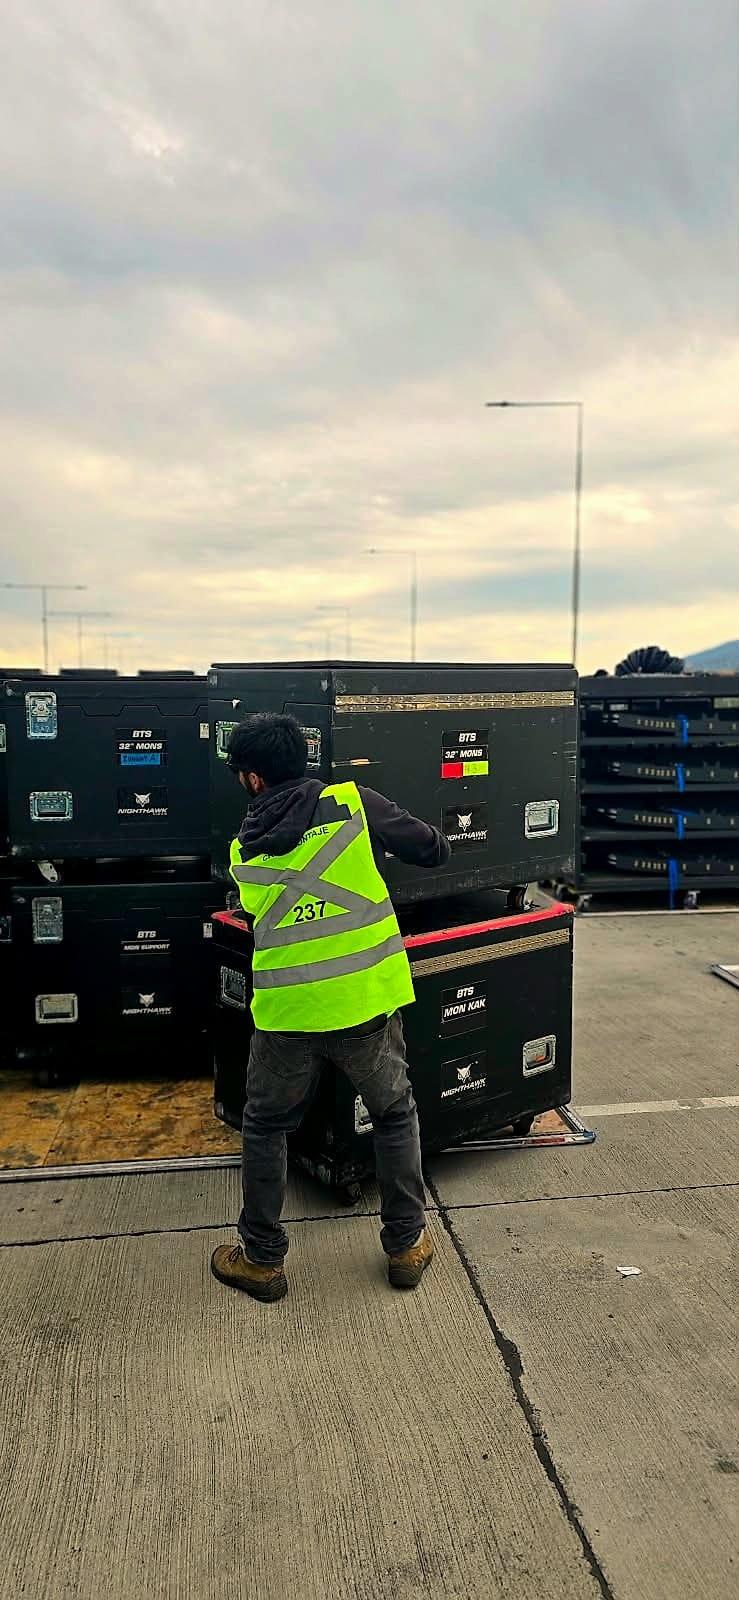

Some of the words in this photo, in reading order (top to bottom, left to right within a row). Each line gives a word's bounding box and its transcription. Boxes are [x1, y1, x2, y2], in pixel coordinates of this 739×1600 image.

[132, 730, 152, 738] BTS
[458, 732, 477, 743] BTS
[135, 742, 163, 750] MONS
[459, 748, 483, 758] MONS
[297, 826, 330, 846] ONTAJE
[446, 830, 488, 841] IGHTHAWK
[293, 900, 327, 923] 237
[137, 930, 157, 939] BTS
[456, 986, 475, 999] BTS
[443, 1004, 466, 1017] MON
[467, 998, 487, 1012] KAK
[441, 1077, 487, 1098] NIGHTHAWK
